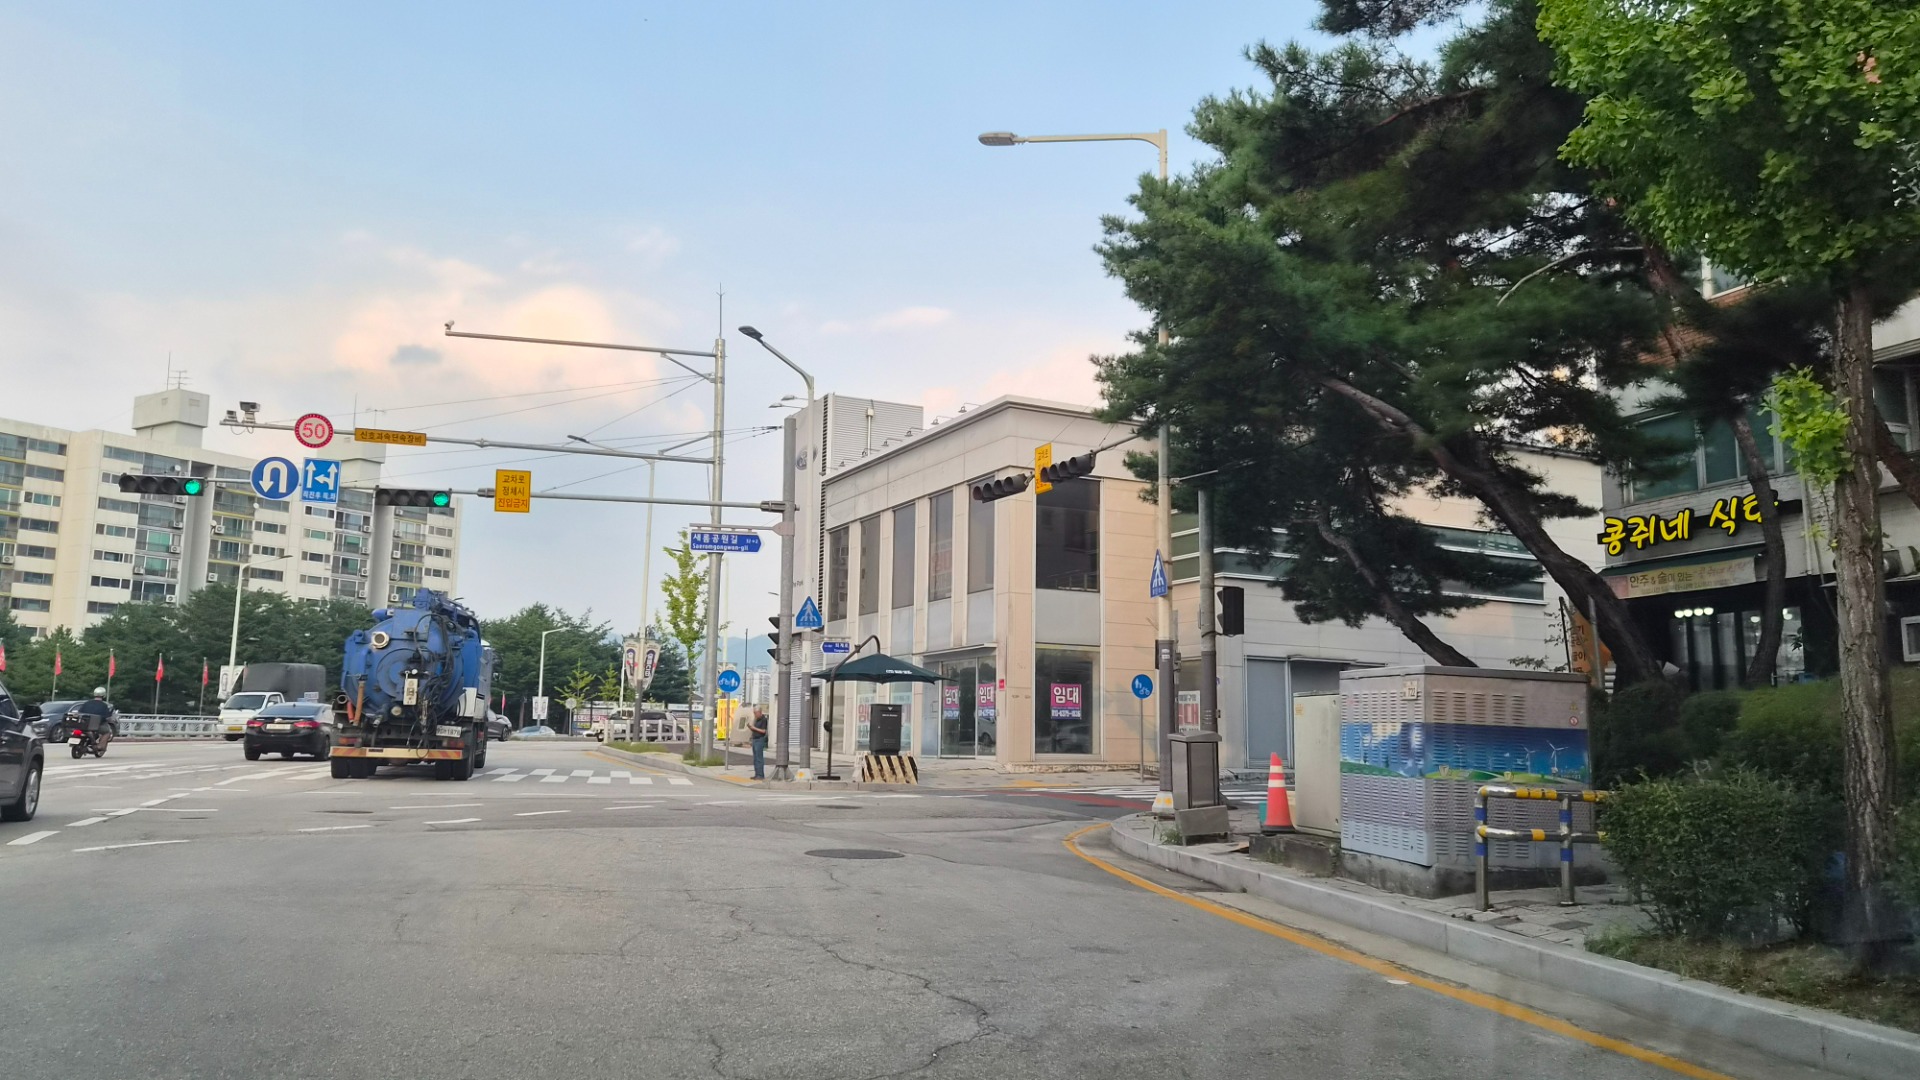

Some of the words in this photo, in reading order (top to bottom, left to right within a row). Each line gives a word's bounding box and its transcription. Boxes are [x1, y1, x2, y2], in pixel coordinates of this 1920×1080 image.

[302, 422, 325, 440] 50
[360, 431, 422, 444] 신호과속단속장비
[502, 474, 525, 484] 교차로
[502, 486, 525, 497] 정체시
[497, 498, 528, 509] 진입금지
[692, 533, 738, 544] 새롬공원길
[1601, 509, 1690, 555] 콩쥐네
[1629, 574, 1649, 588] 안주
[1677, 572, 1693, 582] 있는
[1053, 686, 1079, 704] 임대
